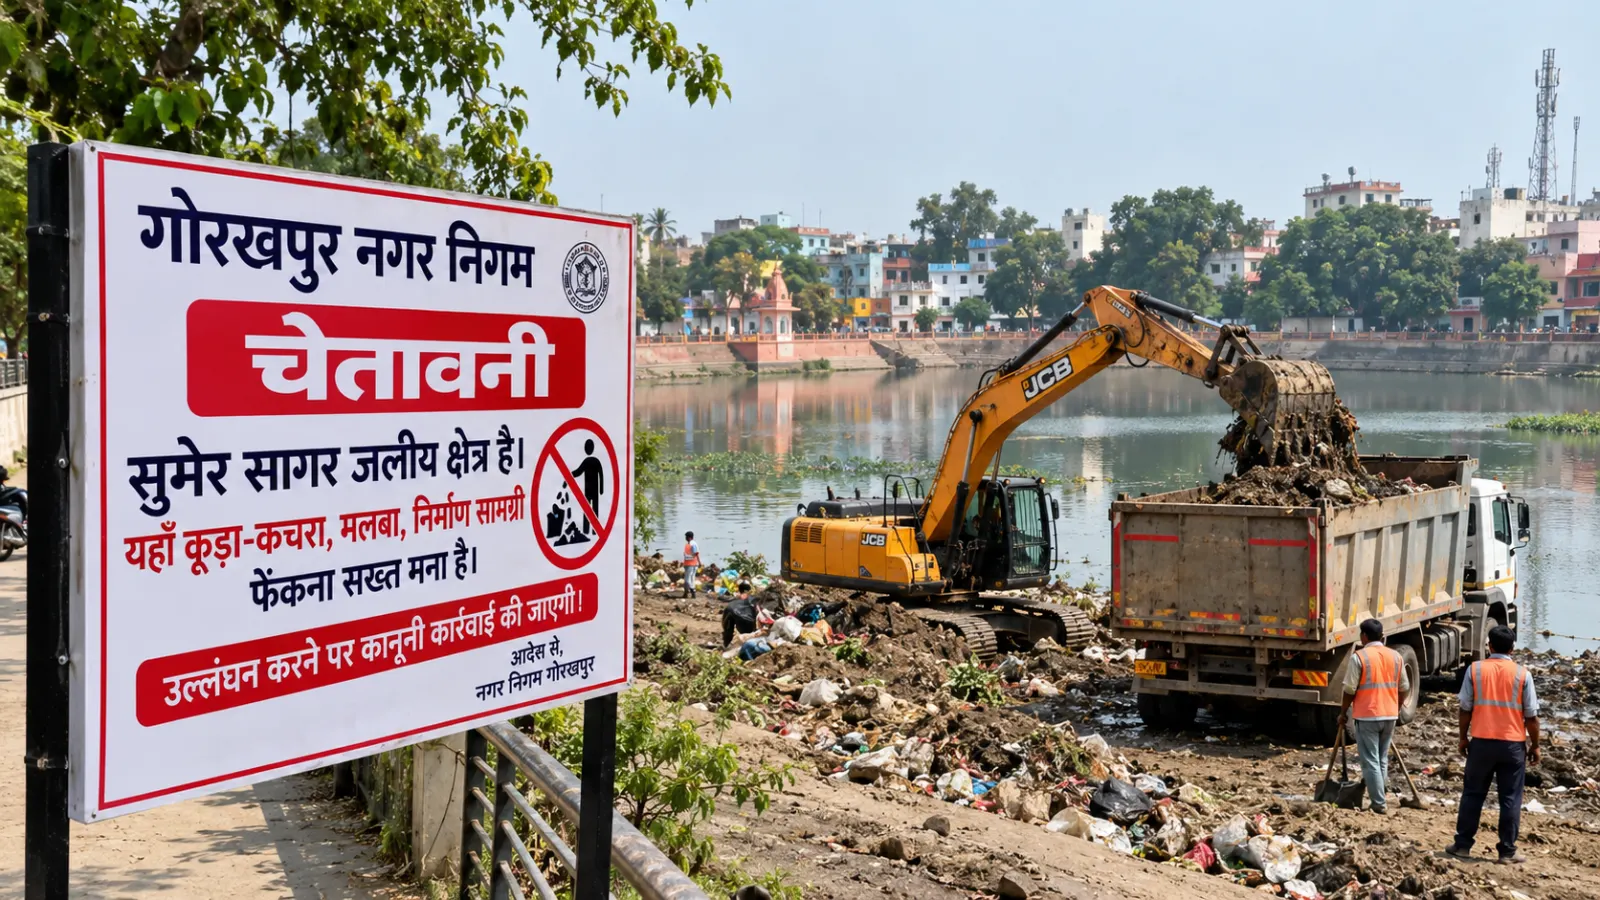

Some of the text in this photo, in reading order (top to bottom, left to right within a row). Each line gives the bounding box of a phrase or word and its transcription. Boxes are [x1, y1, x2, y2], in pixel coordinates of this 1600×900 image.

[137, 187, 342, 293] गोरखपुर
[354, 227, 437, 282] नगर
[446, 220, 536, 288] निगम
[245, 311, 555, 401] चेतावनी
[1024, 356, 1073, 399] JCB
[127, 424, 524, 517] सुमेर सागर जलीय क्षेत्र है।
[124, 484, 526, 576] यहाँ कूड़ा-कचरा, मलबा, निर्माण सामग्री
[861, 533, 886, 547] JCB
[249, 536, 477, 612] फेंकना सख्त मना है।
[162, 656, 261, 707] उल्लंघन
[266, 636, 321, 683] करने
[325, 639, 356, 670] पर
[361, 615, 426, 665] कानूनी
[430, 599, 496, 645] कार्रवाई
[500, 594, 524, 629] की
[475, 655, 596, 701] नगर निगम गोरखपुर
[549, 635, 564, 657] से,
